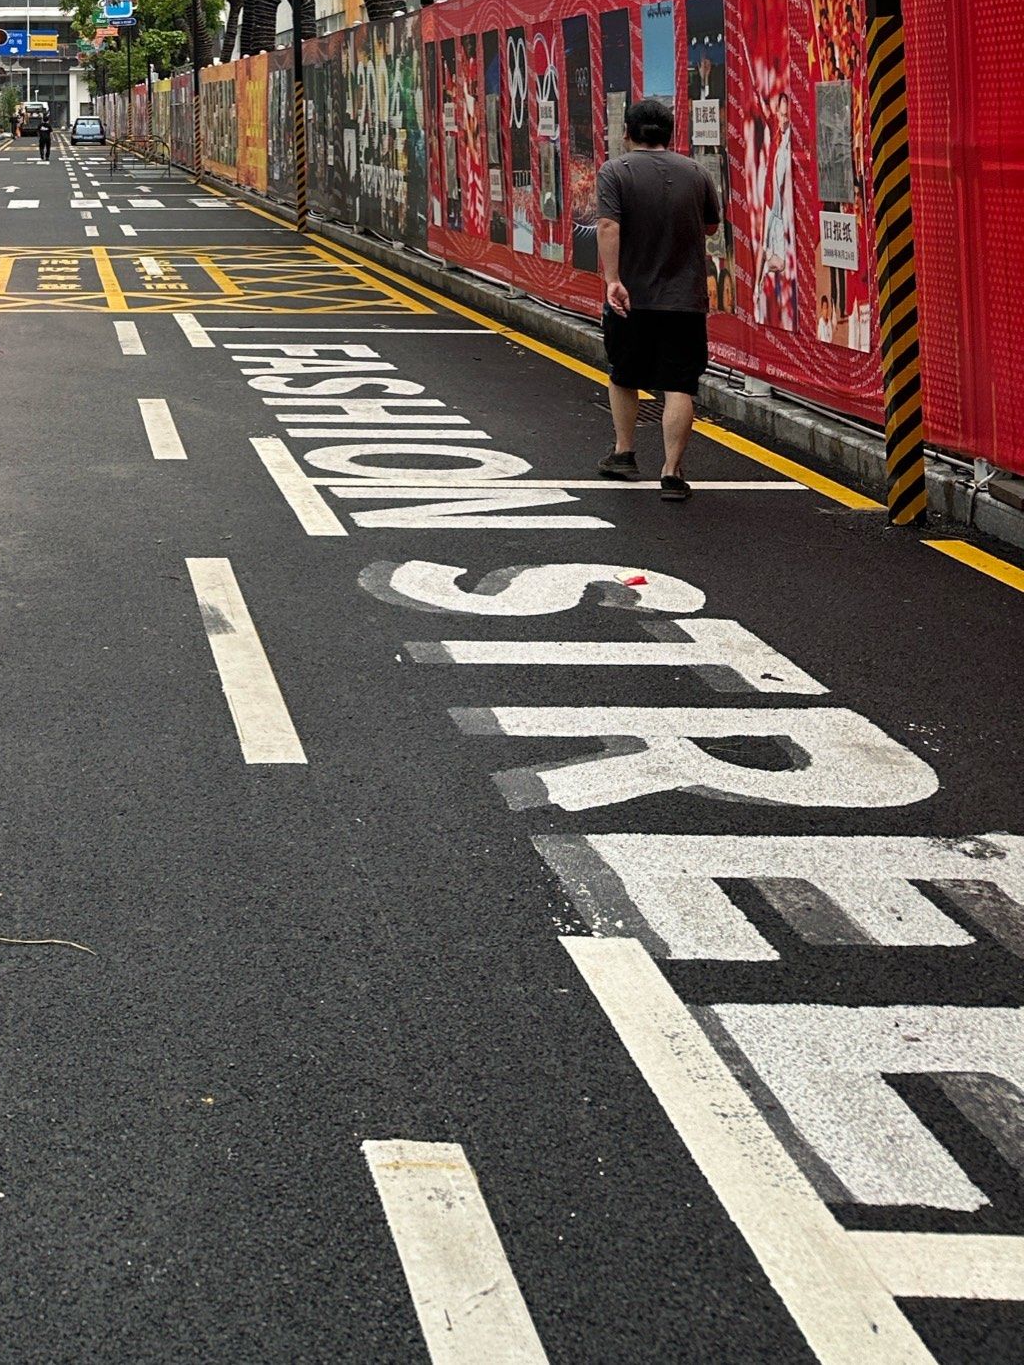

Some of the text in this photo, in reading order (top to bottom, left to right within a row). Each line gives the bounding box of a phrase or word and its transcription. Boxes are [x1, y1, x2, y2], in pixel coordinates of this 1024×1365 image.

[694, 105, 717, 124] 旧报纸
[822, 219, 853, 244] 旧报纸
[223, 343, 616, 531] FASHION
